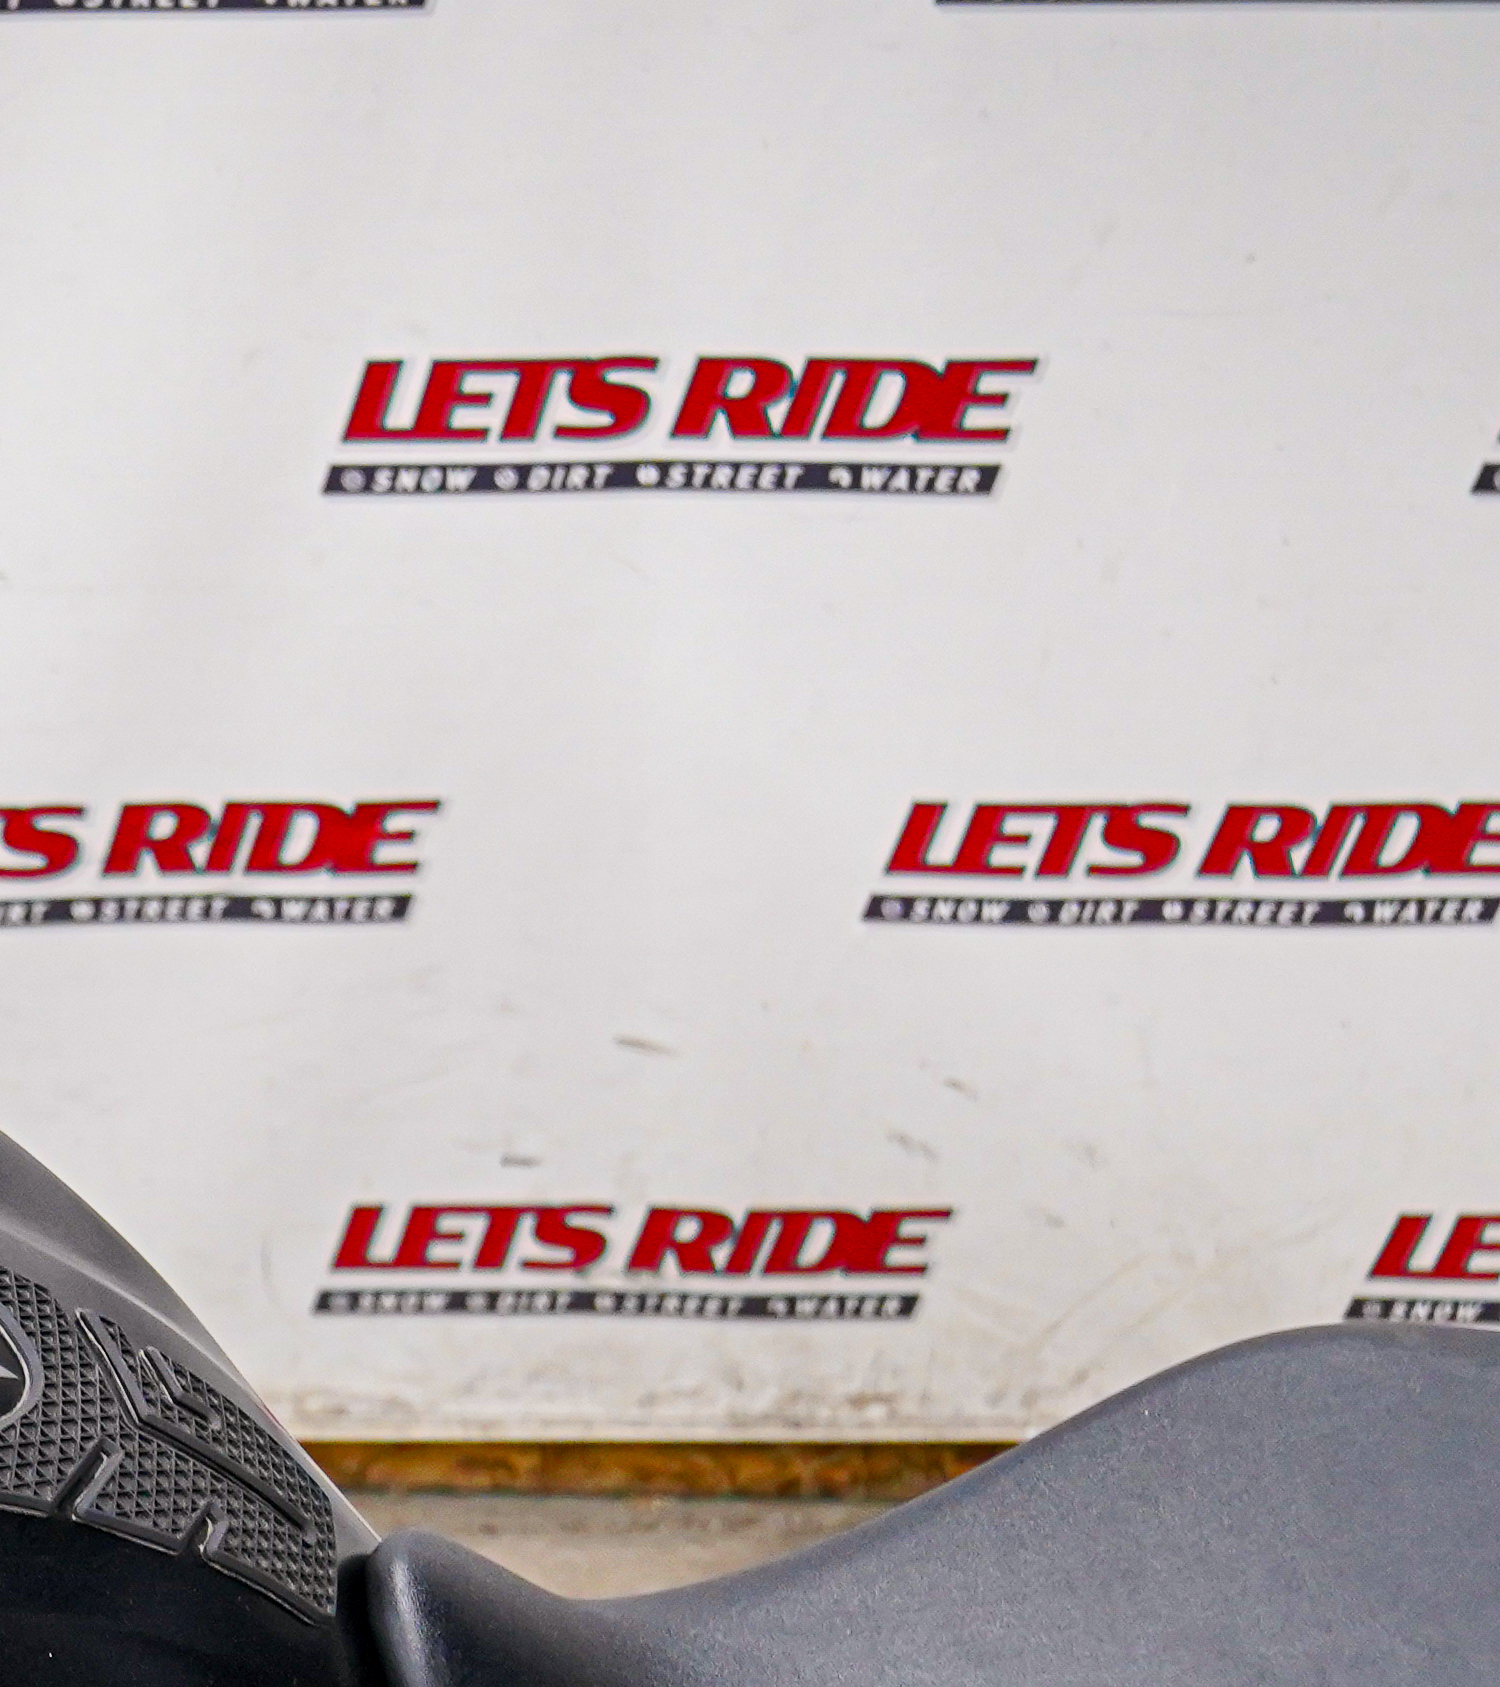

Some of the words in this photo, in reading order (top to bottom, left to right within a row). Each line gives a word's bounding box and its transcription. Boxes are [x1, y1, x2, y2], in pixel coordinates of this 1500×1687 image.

[344, 355, 657, 442] LETS
[672, 357, 1036, 442] RIDE
[371, 465, 474, 493] SNOW
[528, 465, 614, 491] DIRT
[664, 464, 803, 490] STREET
[861, 466, 983, 492] WATER
[104, 801, 444, 875] RIDE
[886, 802, 1184, 877] LETS
[101, 895, 230, 920] STREET
[281, 894, 394, 918] WATER
[909, 898, 1011, 922] SNOW
[1060, 898, 1139, 922] DIRT
[1191, 898, 1319, 922] STREET
[1372, 897, 1485, 922] WATER
[332, 1204, 612, 1272] LETS
[628, 1207, 954, 1276] RIDE
